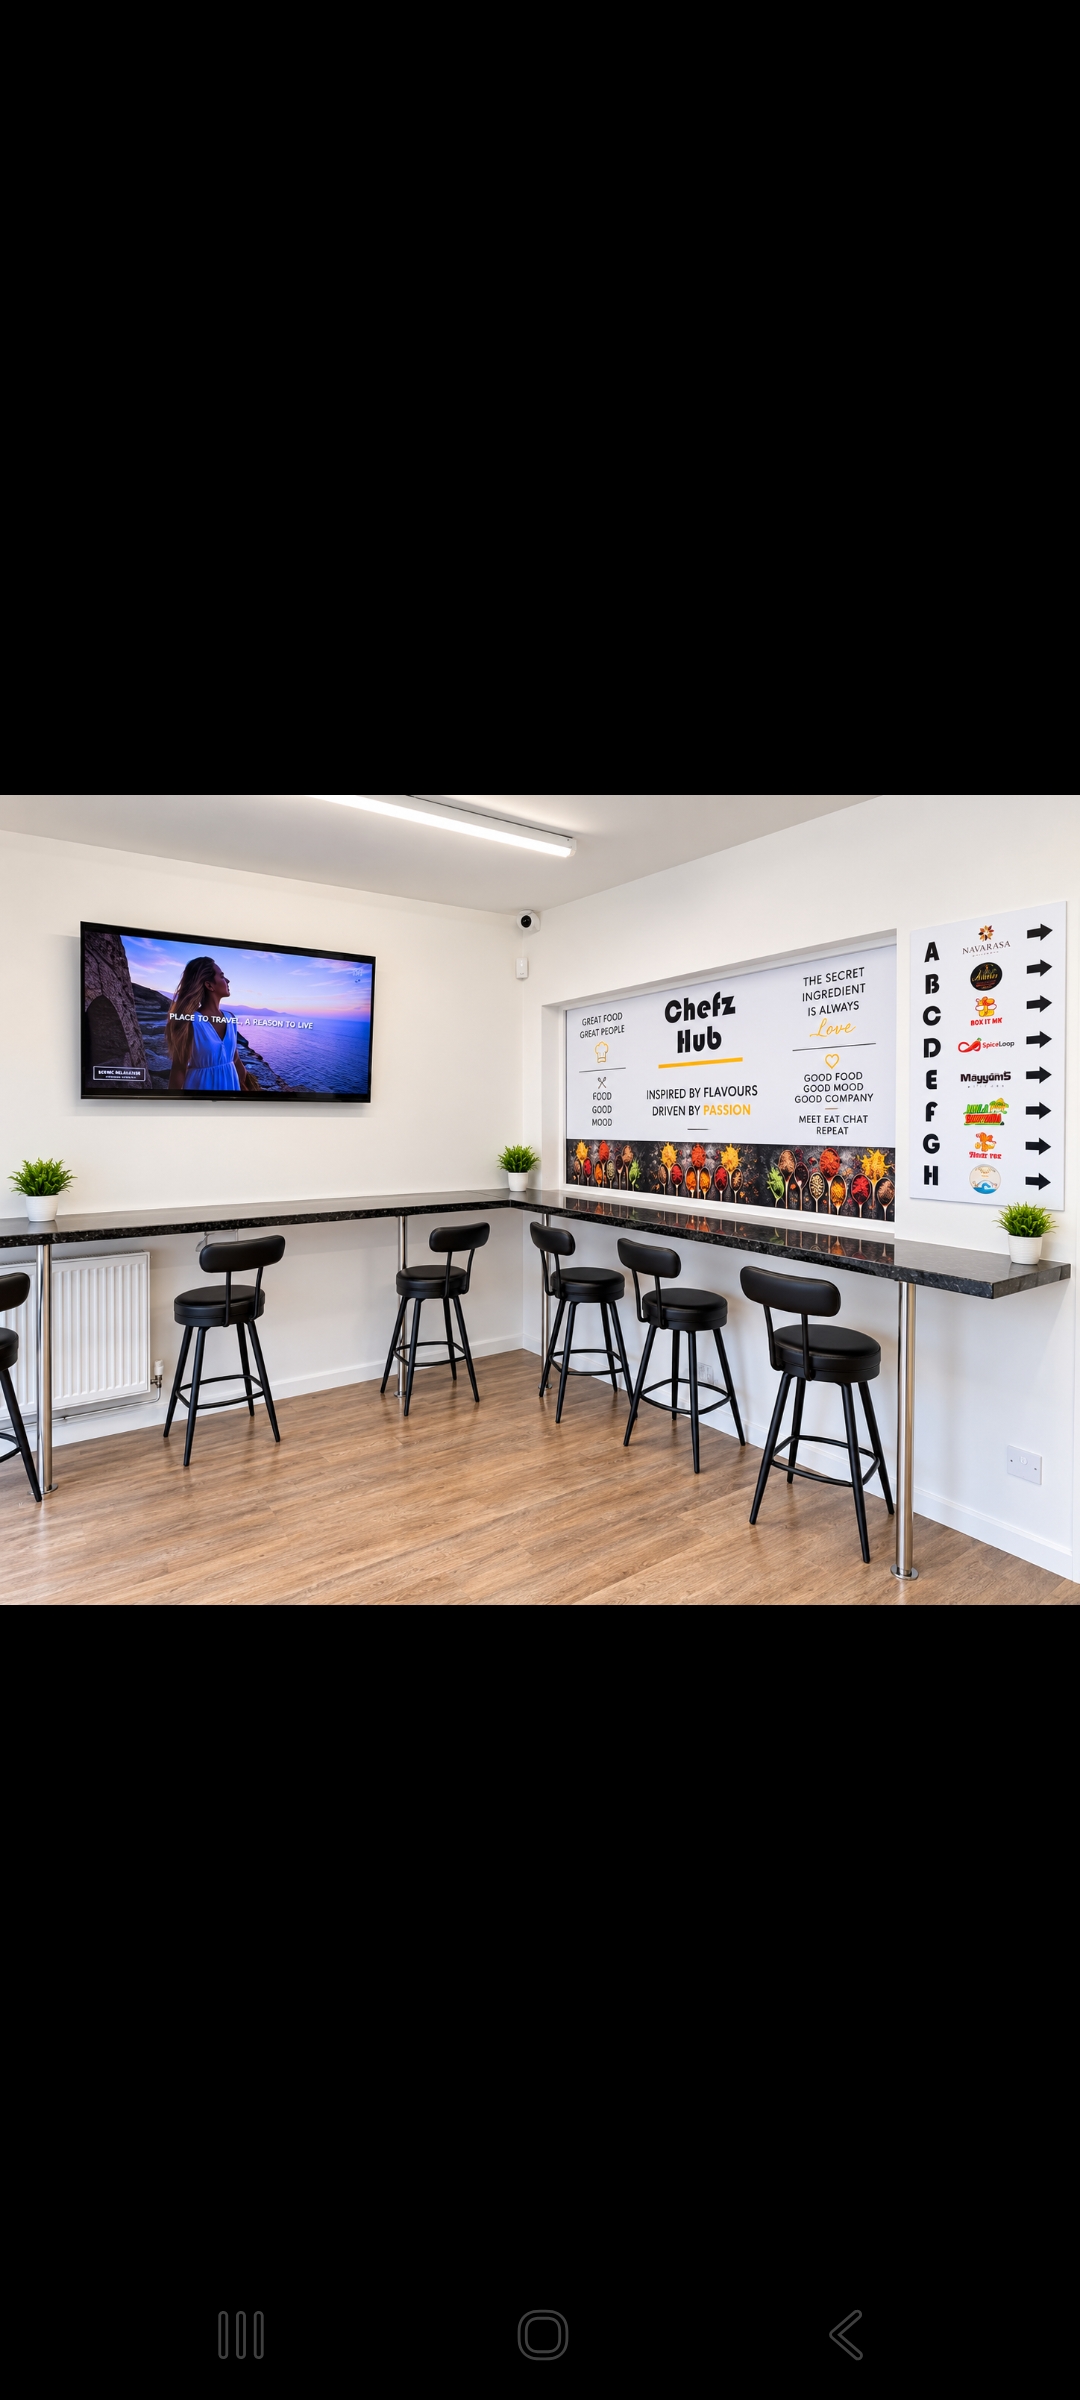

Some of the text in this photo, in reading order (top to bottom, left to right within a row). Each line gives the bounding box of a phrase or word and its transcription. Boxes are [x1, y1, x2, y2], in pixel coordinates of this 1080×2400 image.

[924, 941, 940, 963] A
[962, 940, 1011, 955] NAVARASA
[803, 966, 865, 987] THE SECRET
[925, 973, 940, 995] B
[802, 982, 866, 1002] INGREDIENT
[664, 991, 736, 1024] Chefz
[807, 1000, 860, 1017] IS ALWAYS
[922, 1005, 942, 1026] C
[169, 1012, 314, 1030] PLACE TO TRAVEL, A REASON TO LIVE
[581, 1012, 623, 1026] GREAT FOOD
[809, 1017, 857, 1038] Love
[579, 1024, 625, 1039] GREAT PEOPLE
[677, 1025, 722, 1054] Hub
[923, 1037, 942, 1059] D
[803, 1071, 863, 1082] GOOD FOOD
[925, 1069, 938, 1090] E
[646, 1084, 758, 1100] INSPIRED BY FLAVOURS
[803, 1082, 864, 1093] GOOD MOOD
[592, 1092, 612, 1101] FOOD
[794, 1093, 874, 1103] GOOD COMPANY
[591, 1105, 612, 1114] GOOD
[652, 1103, 751, 1116] DRIVEN BY PASSION
[925, 1101, 939, 1122] F
[591, 1118, 613, 1127] MOOD
[798, 1114, 868, 1124] MEET EAT CHAT
[816, 1126, 849, 1135] REPEAT
[922, 1133, 941, 1155] G
[923, 1165, 939, 1186] H
